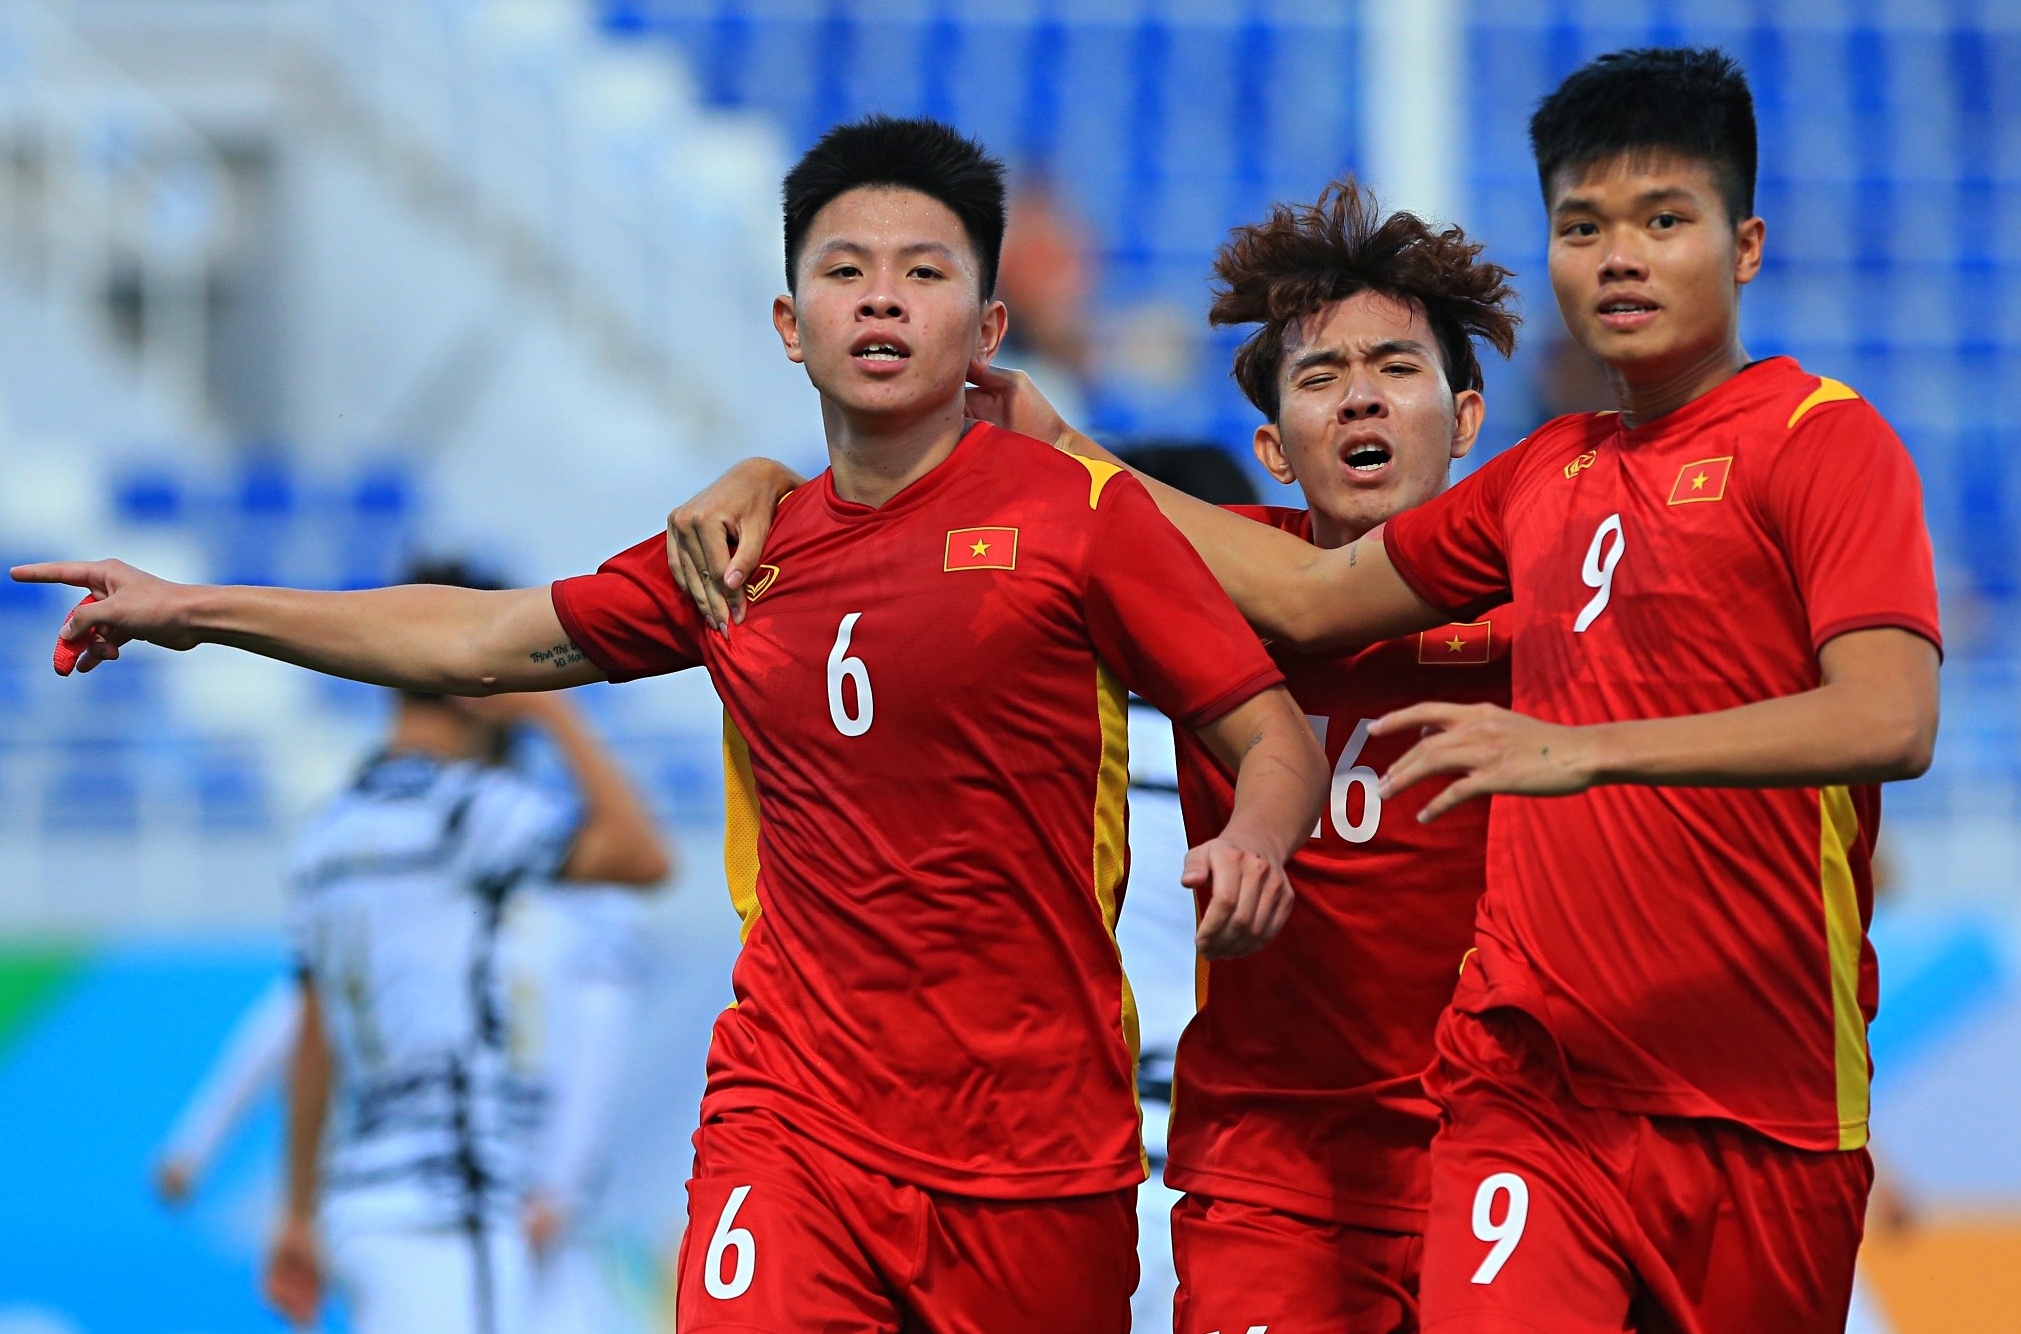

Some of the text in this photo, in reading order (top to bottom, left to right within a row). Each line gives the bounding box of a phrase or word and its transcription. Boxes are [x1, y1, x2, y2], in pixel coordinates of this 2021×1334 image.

[1573, 513, 1626, 633] 9
[827, 612, 874, 737] 6
[703, 1184, 757, 1301] 6
[1470, 1171, 1530, 1286] 9
